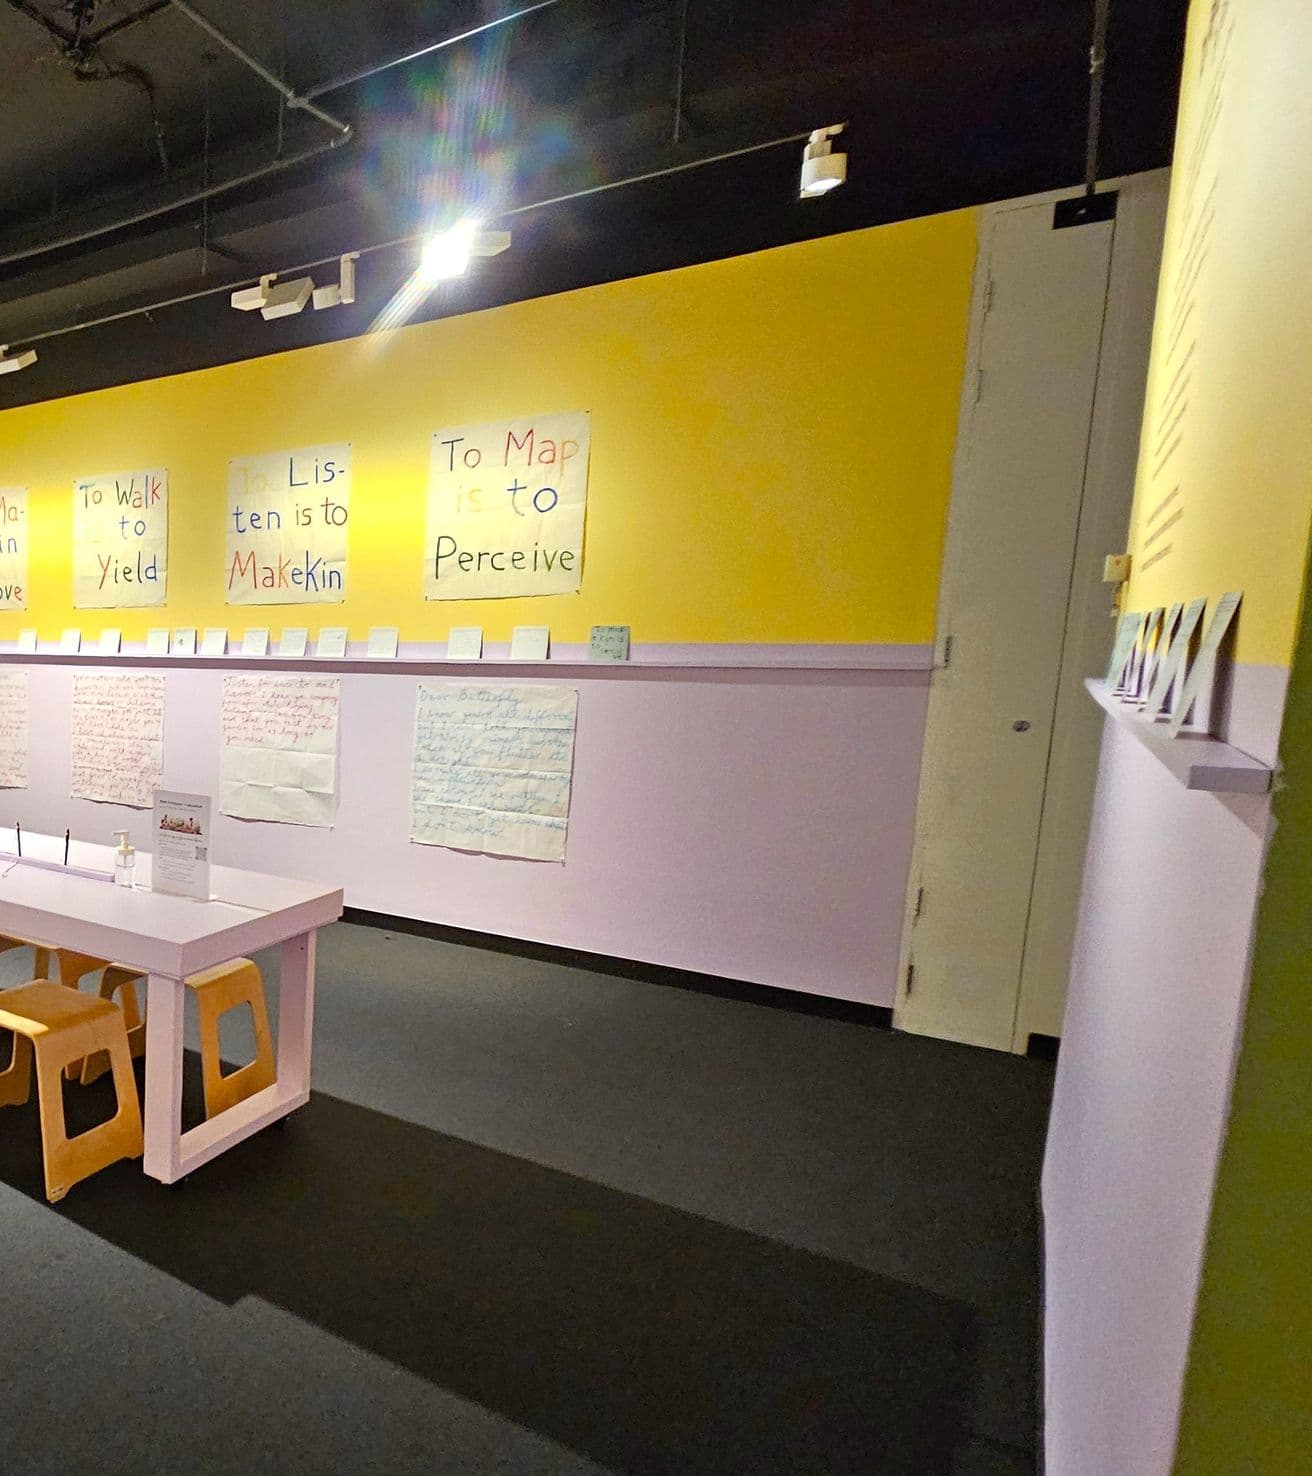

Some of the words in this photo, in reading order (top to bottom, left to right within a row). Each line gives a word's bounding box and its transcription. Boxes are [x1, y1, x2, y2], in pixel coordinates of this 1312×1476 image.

[288, 456, 345, 487] Lis-
[441, 438, 482, 472] To
[504, 428, 580, 478] Map
[79, 484, 103, 509] To
[115, 474, 162, 511] Walk
[455, 482, 484, 513] is
[506, 478, 558, 517] to
[118, 515, 146, 540] to
[232, 505, 281, 534] ten
[294, 503, 312, 527] is
[320, 496, 348, 527] to
[97, 551, 158, 590] Yield
[435, 535, 575, 580] Perceive
